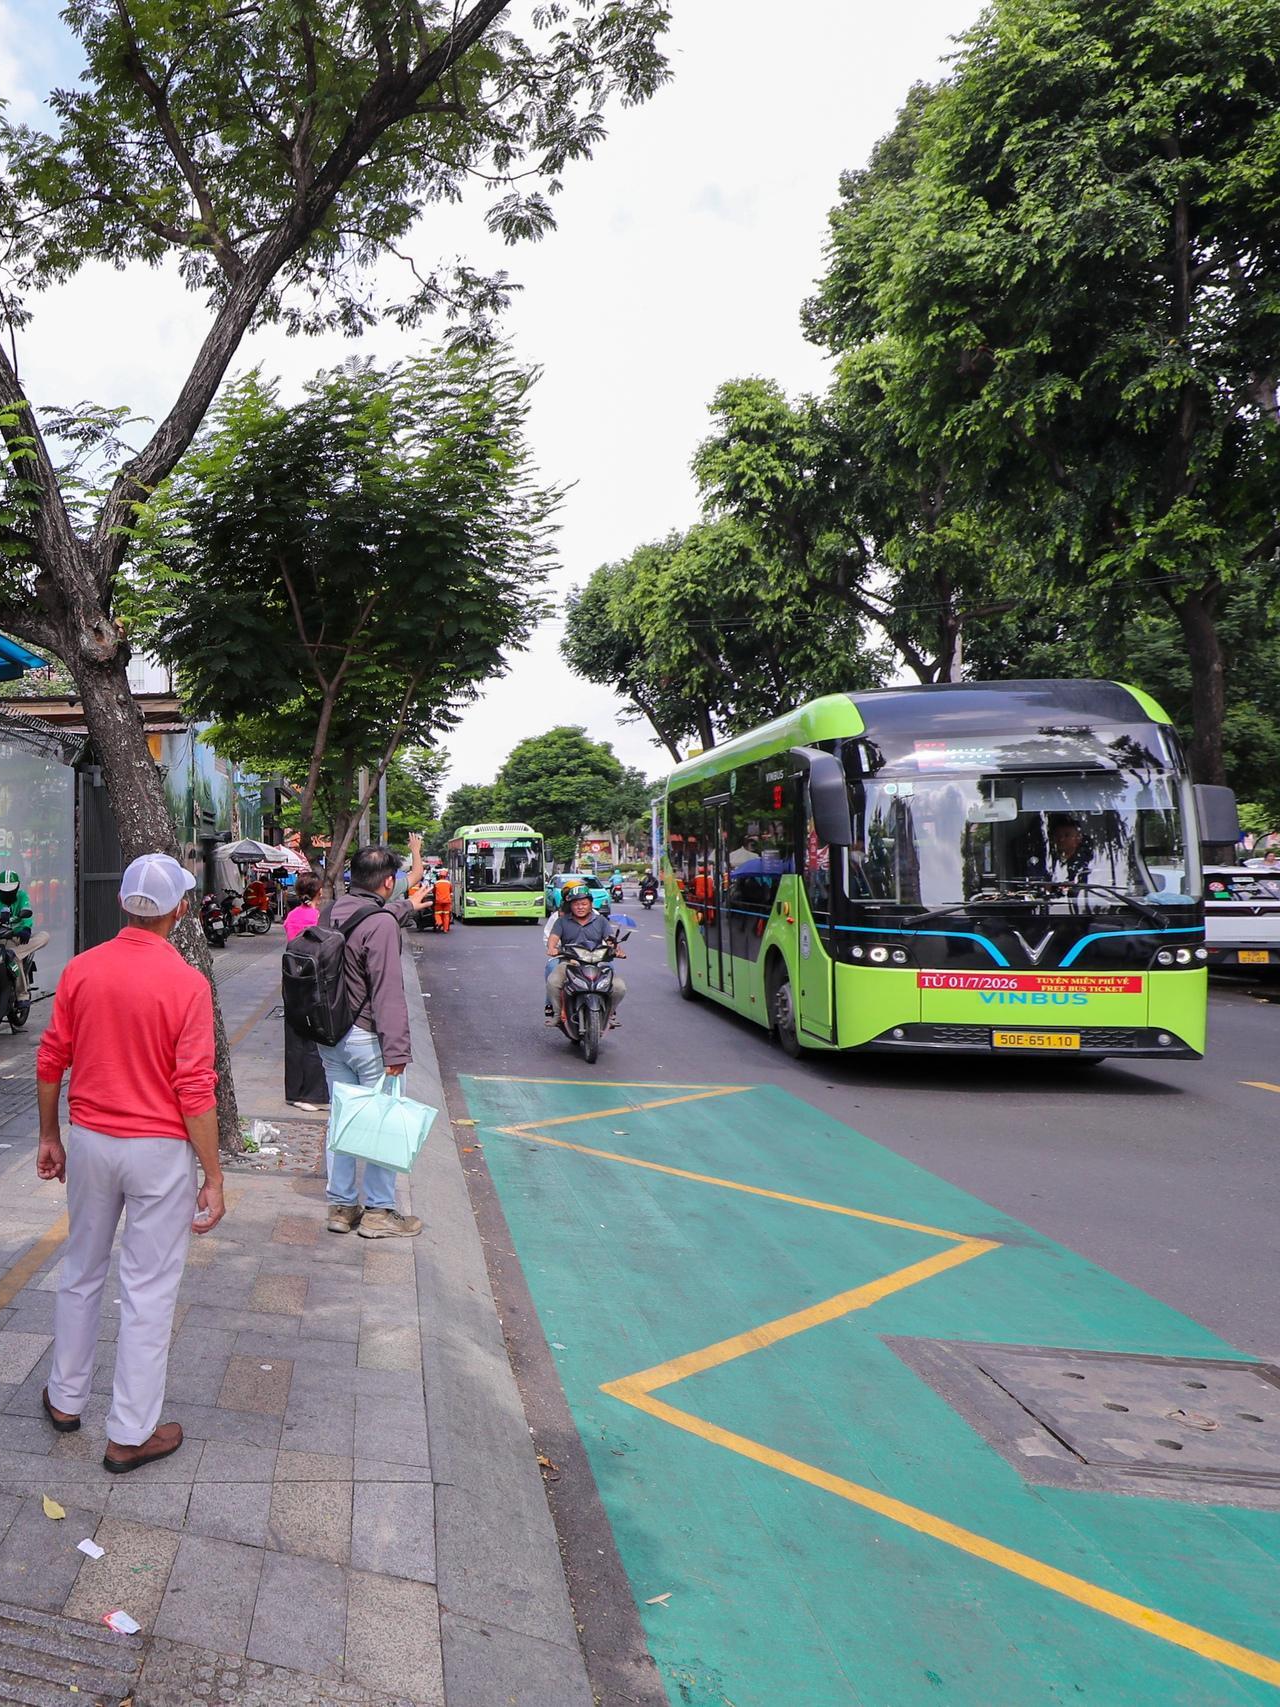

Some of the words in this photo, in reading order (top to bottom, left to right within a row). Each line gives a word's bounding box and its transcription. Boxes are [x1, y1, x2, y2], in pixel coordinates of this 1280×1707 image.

[921, 974, 946, 987] TỪ
[948, 977, 1018, 989] 01/7/2026
[1036, 976, 1069, 985] TUYẾN
[1070, 976, 1097, 985] MIỄN
[1098, 977, 1115, 985] PHÍ
[1116, 976, 1129, 985] VÉ
[978, 992, 1089, 1005] VINBUS
[1000, 1034, 1072, 1047] 50E-651.10
